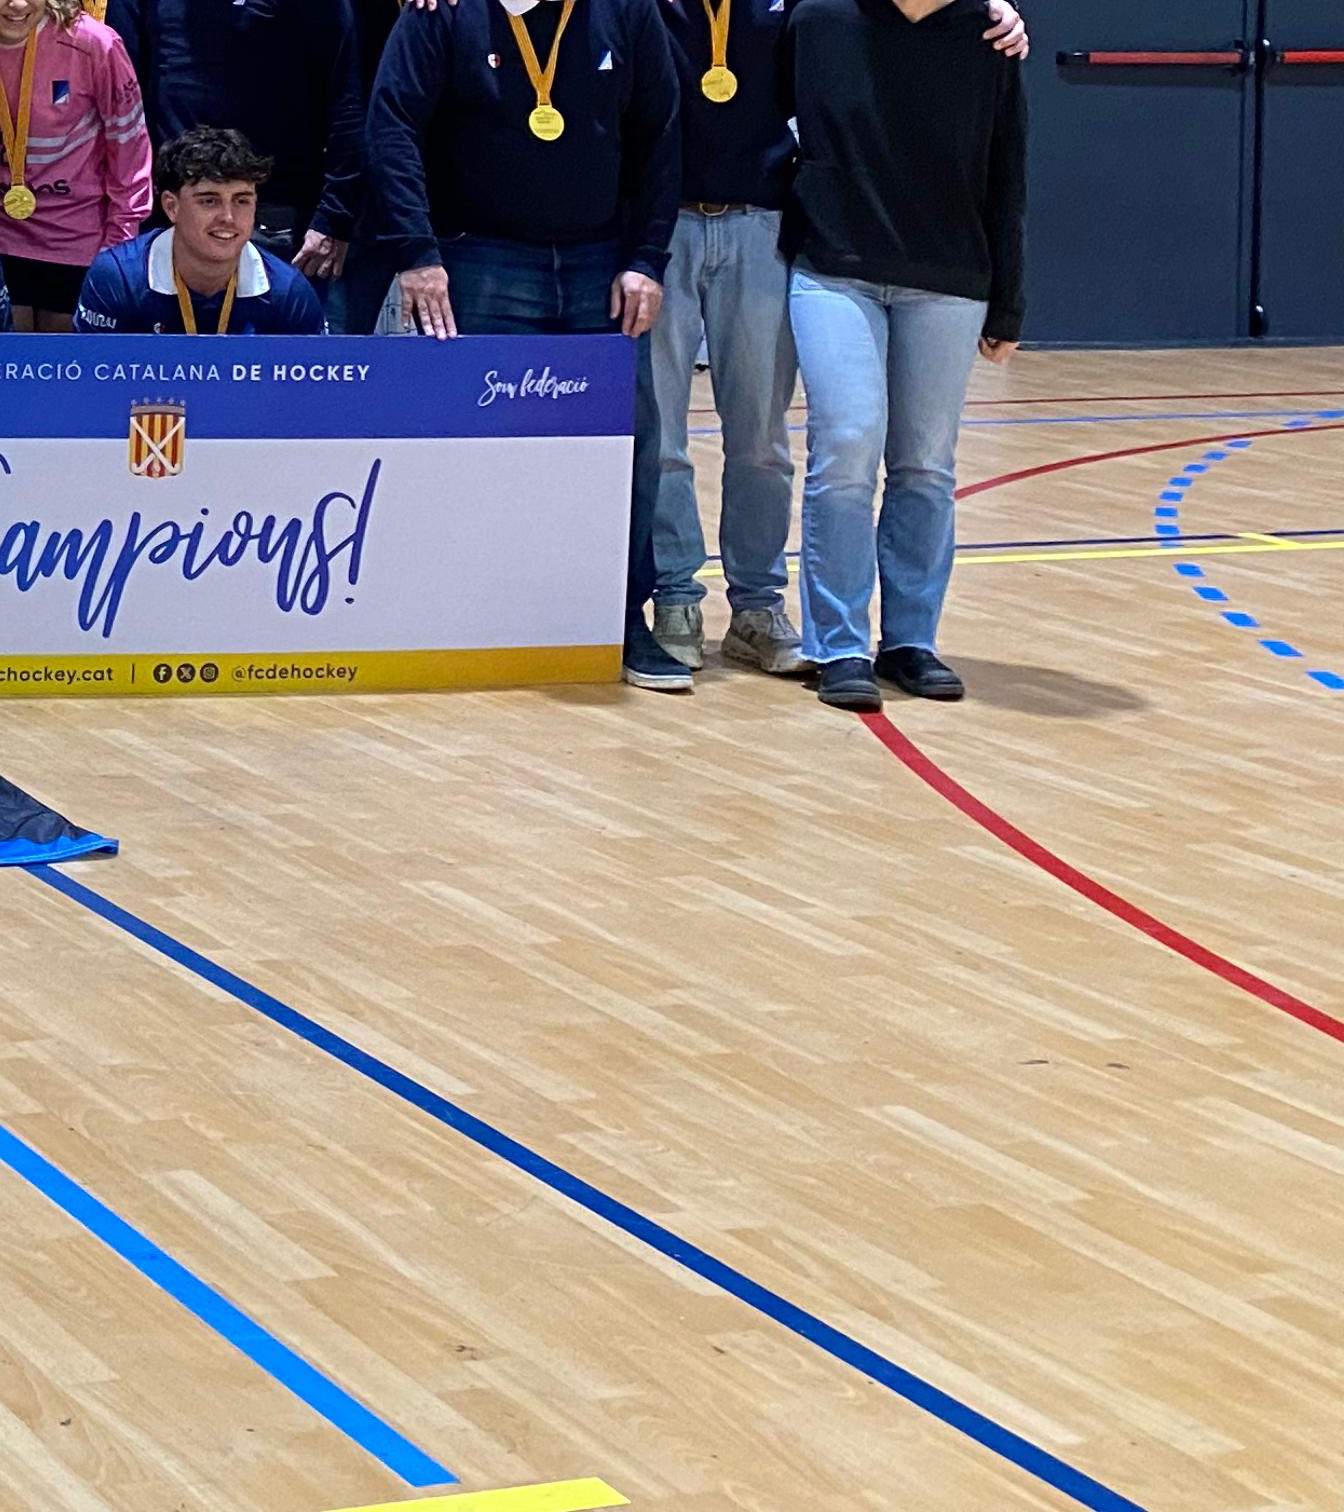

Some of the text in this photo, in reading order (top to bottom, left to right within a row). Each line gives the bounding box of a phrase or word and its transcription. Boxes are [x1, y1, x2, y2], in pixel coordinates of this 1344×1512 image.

[94, 364, 220, 381] CATALANA
[232, 364, 261, 381] DE
[273, 364, 370, 381] HOCKEY
[477, 366, 589, 407] Som federació
[231, 663, 358, 683] @fcdehockey
